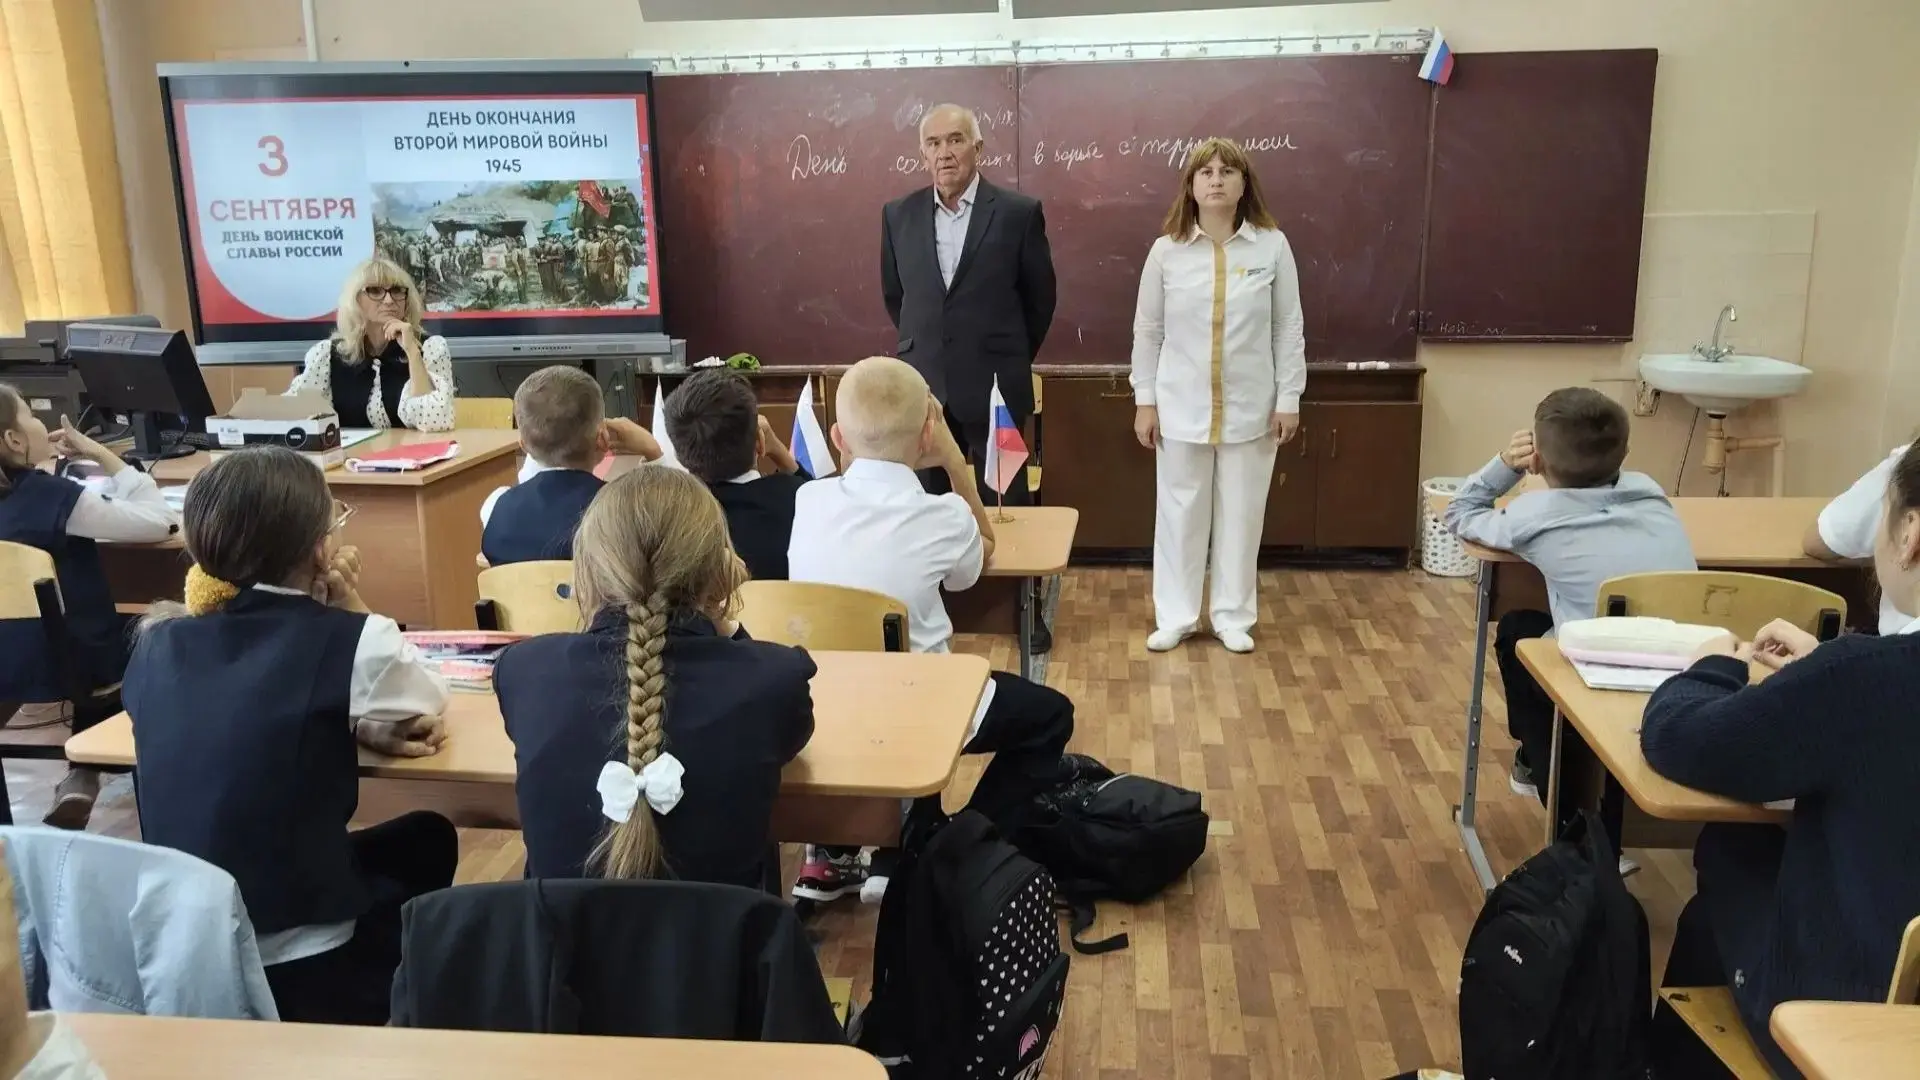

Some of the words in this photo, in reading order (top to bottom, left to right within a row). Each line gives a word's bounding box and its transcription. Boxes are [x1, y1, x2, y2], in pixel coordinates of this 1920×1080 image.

[426, 111, 472, 128] ДЕНЬ
[475, 110, 576, 126] ОКОНЧАНИЯ
[394, 132, 458, 150] ВТОРОЙ
[462, 131, 543, 149] МИРОВОЙ
[548, 131, 608, 149] ВОЙНЫ
[257, 135, 289, 177] 3
[786, 134, 847, 181] День
[485, 159, 522, 173] 1945
[209, 197, 356, 222] СЕНТЯБРЯ
[221, 230, 260, 244] ДЕНЬ
[263, 226, 344, 242] ВОИНСКОЙ
[226, 247, 281, 260] СЛАВЫ
[284, 246, 343, 258] РОССИИ
